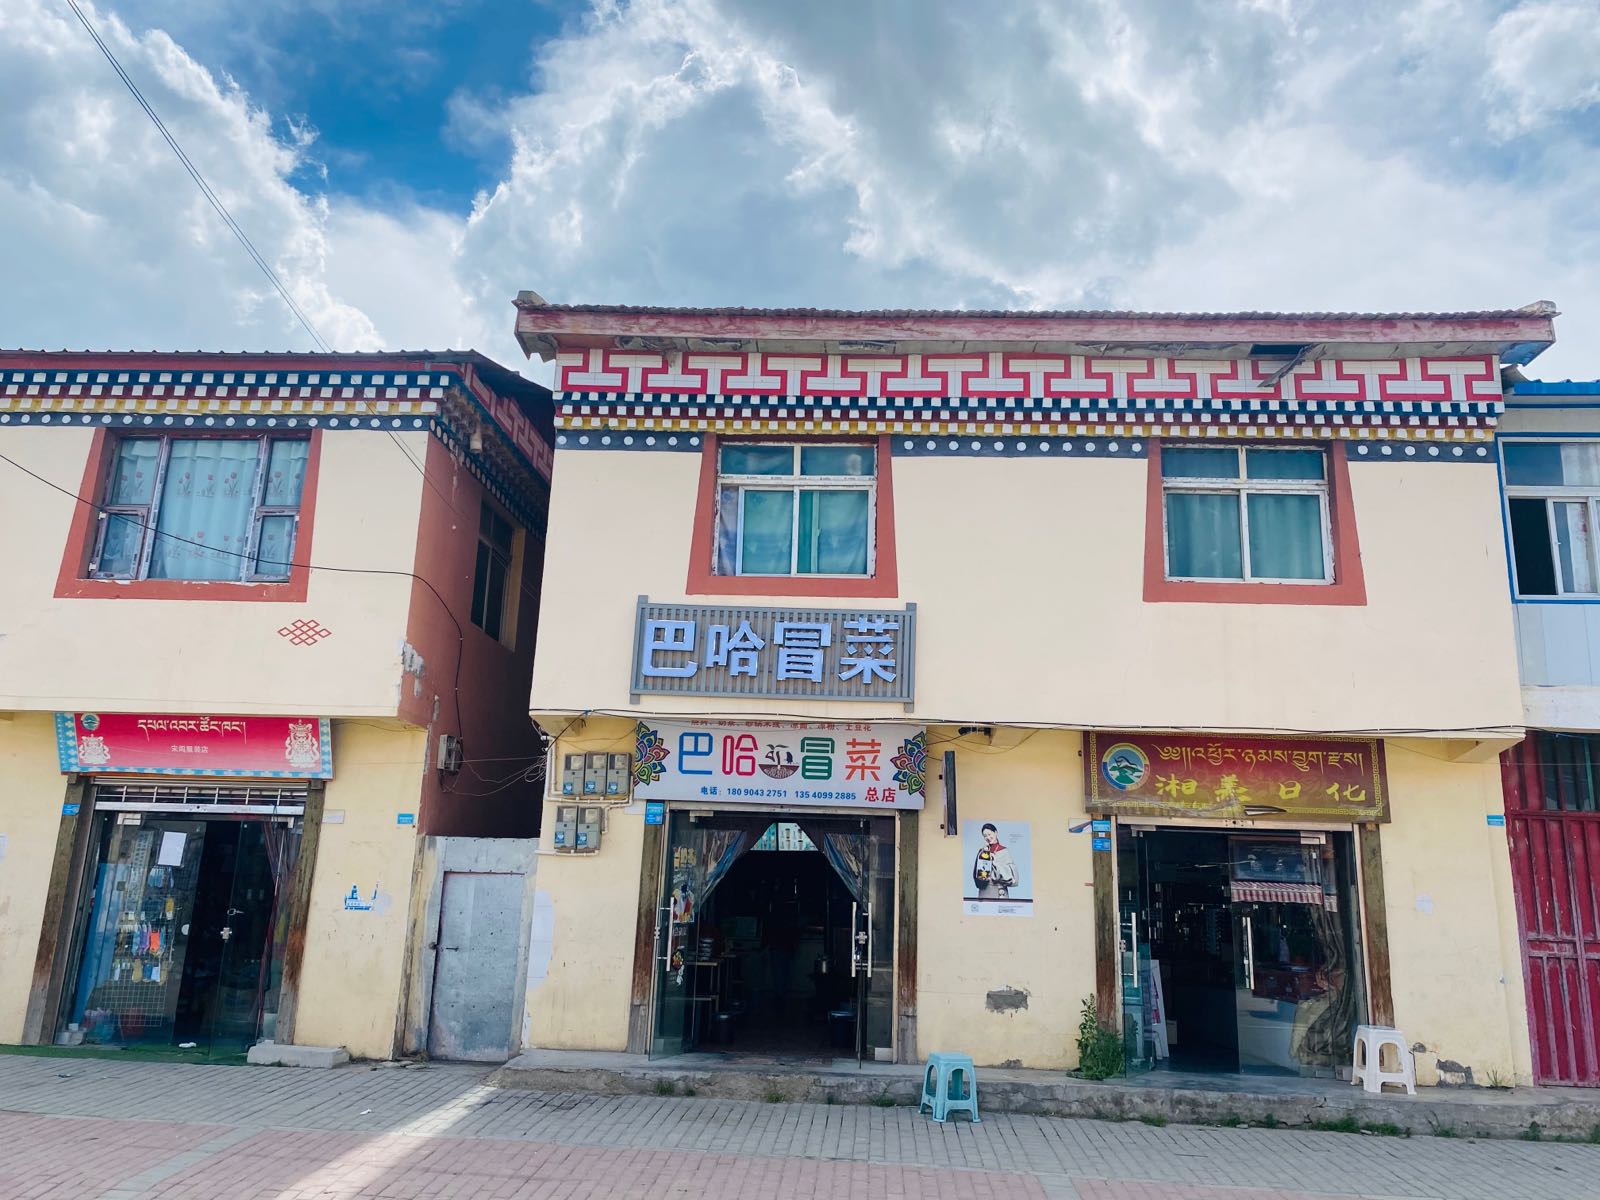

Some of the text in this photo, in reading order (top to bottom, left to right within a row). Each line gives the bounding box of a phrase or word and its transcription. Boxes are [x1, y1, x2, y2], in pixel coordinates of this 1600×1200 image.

[642, 617, 899, 684] 巴哈冒菜
[678, 732, 881, 782] 巴哈冒菜
[865, 786, 896, 803] 总店
